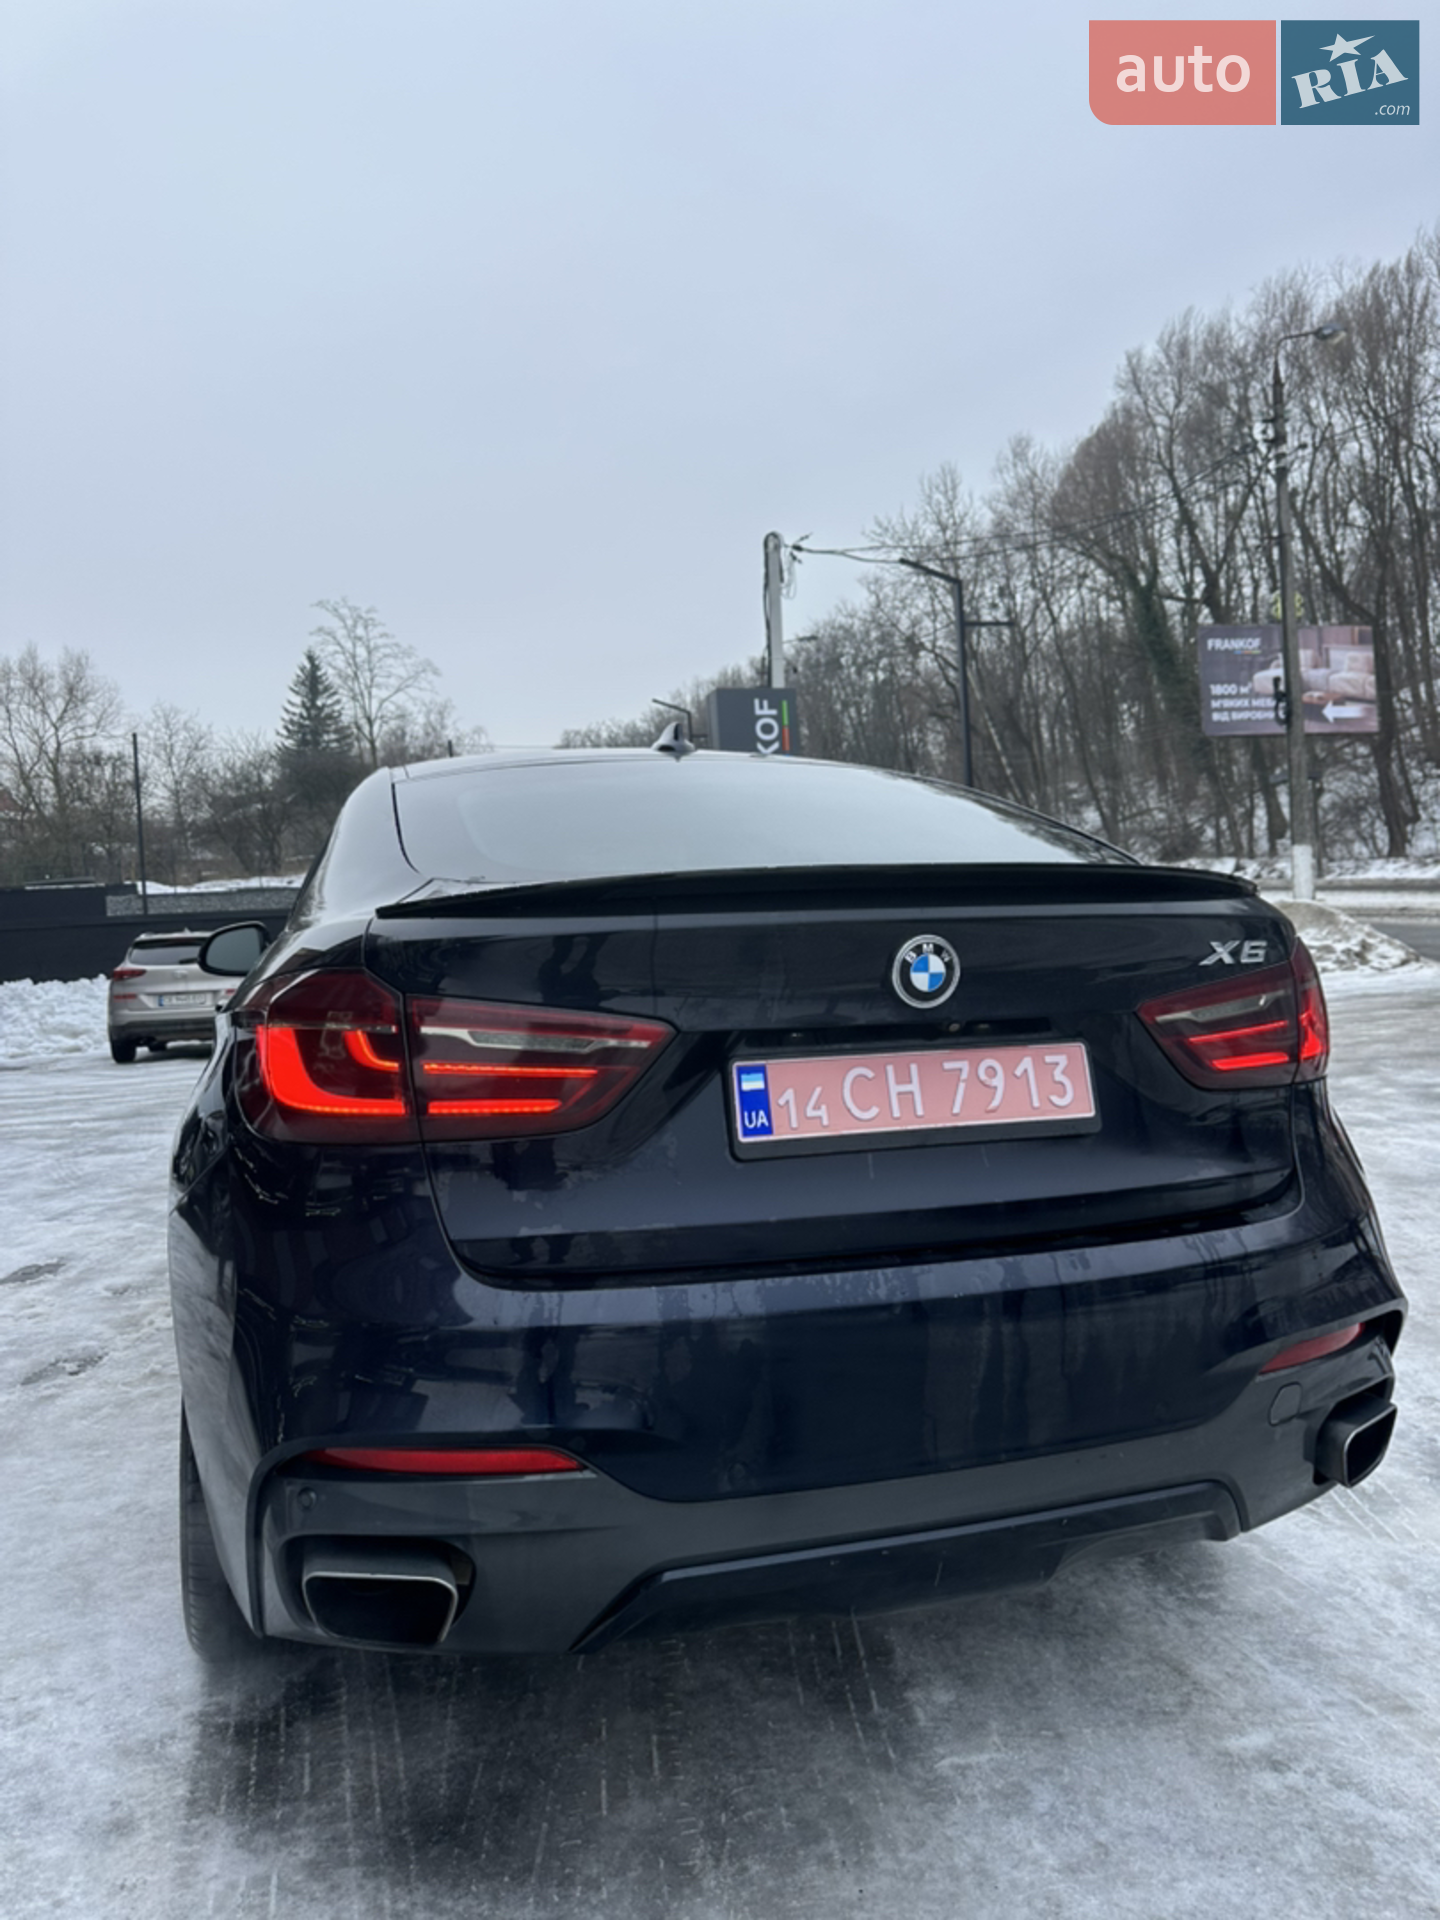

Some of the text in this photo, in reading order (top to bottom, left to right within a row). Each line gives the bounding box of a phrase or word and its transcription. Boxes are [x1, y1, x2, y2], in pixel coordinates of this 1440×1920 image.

[1207, 637, 1261, 651] FRANKOF
[1209, 683, 1238, 696] 1800
[904, 942, 952, 964] BMW
[1198, 939, 1268, 966] X6
[777, 1053, 1075, 1129] 14 CH 7913
[743, 1109, 770, 1129] UA
